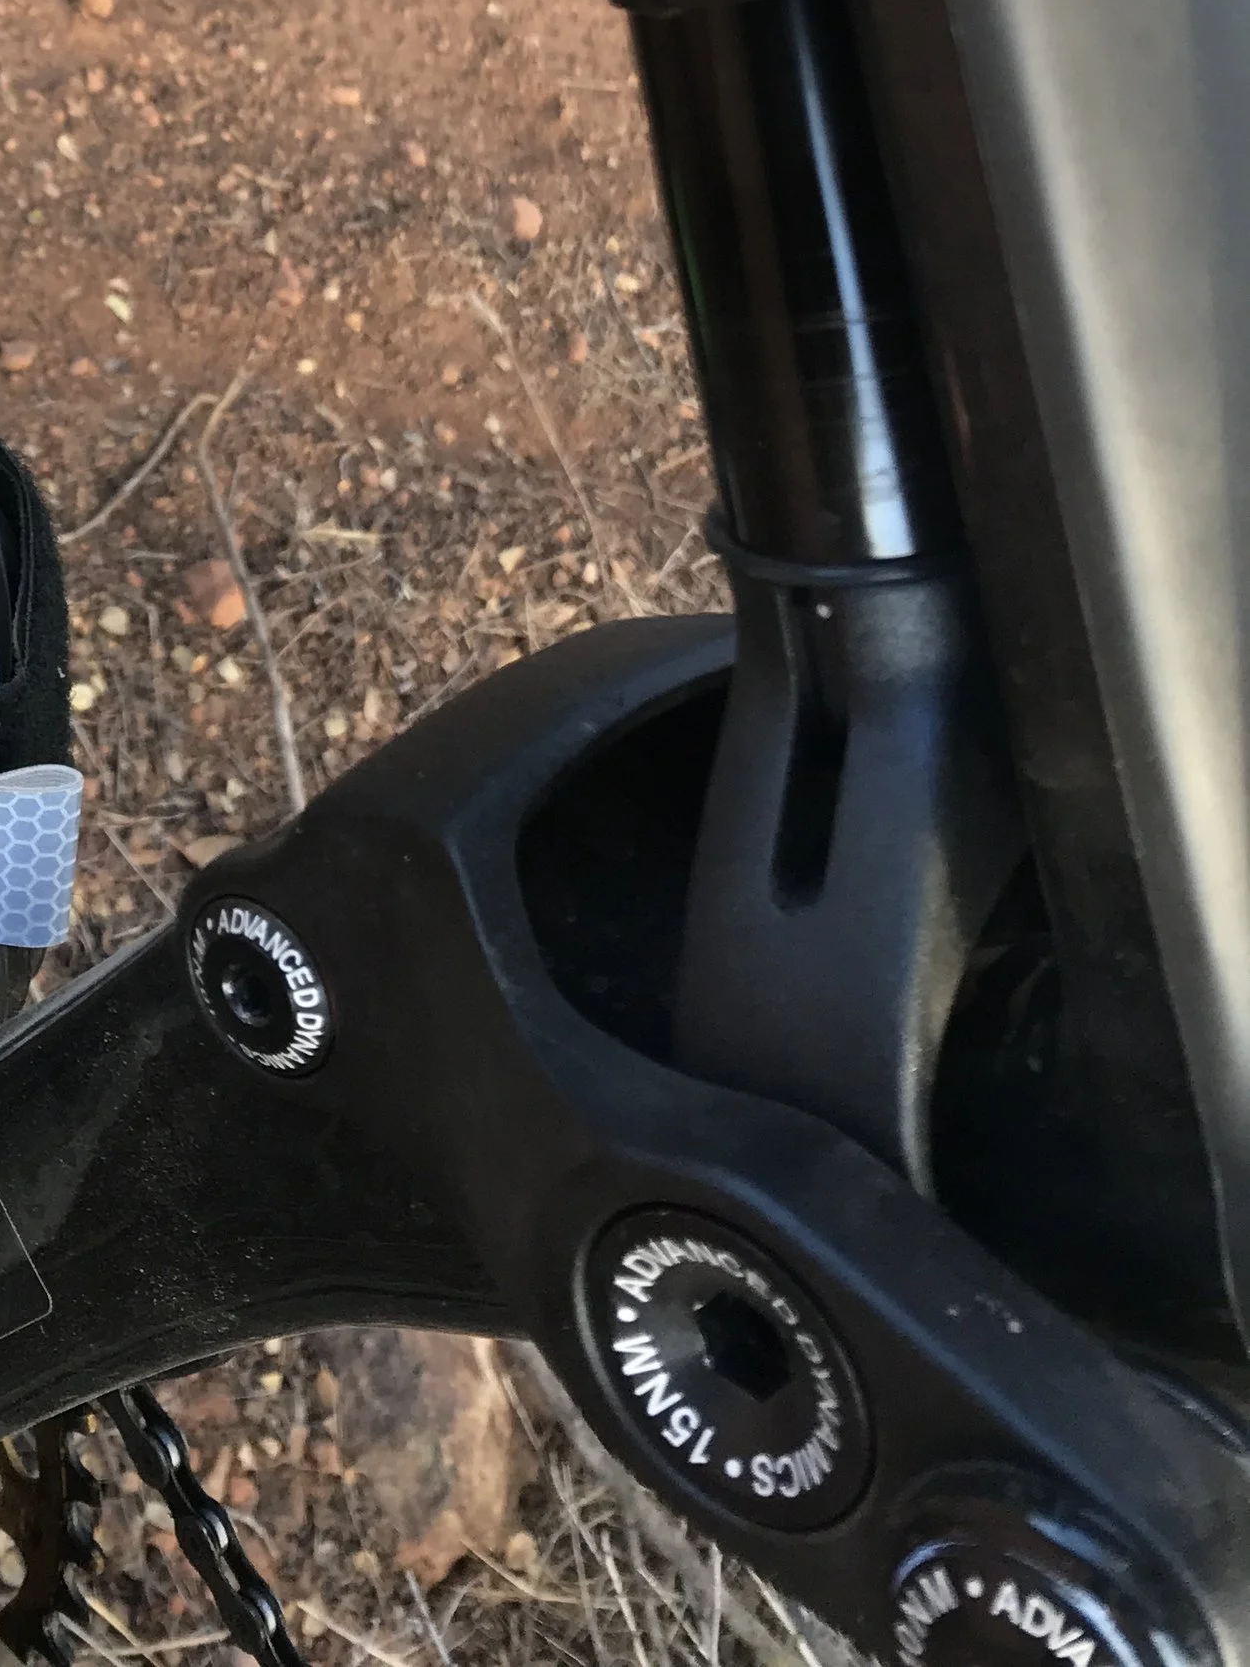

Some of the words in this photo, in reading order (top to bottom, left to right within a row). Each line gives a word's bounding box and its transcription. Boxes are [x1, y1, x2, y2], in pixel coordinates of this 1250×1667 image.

[217, 908, 320, 1008] ADVANCED
[613, 1238, 798, 1325] ADVANCED
[613, 1334, 715, 1464] 15NM
